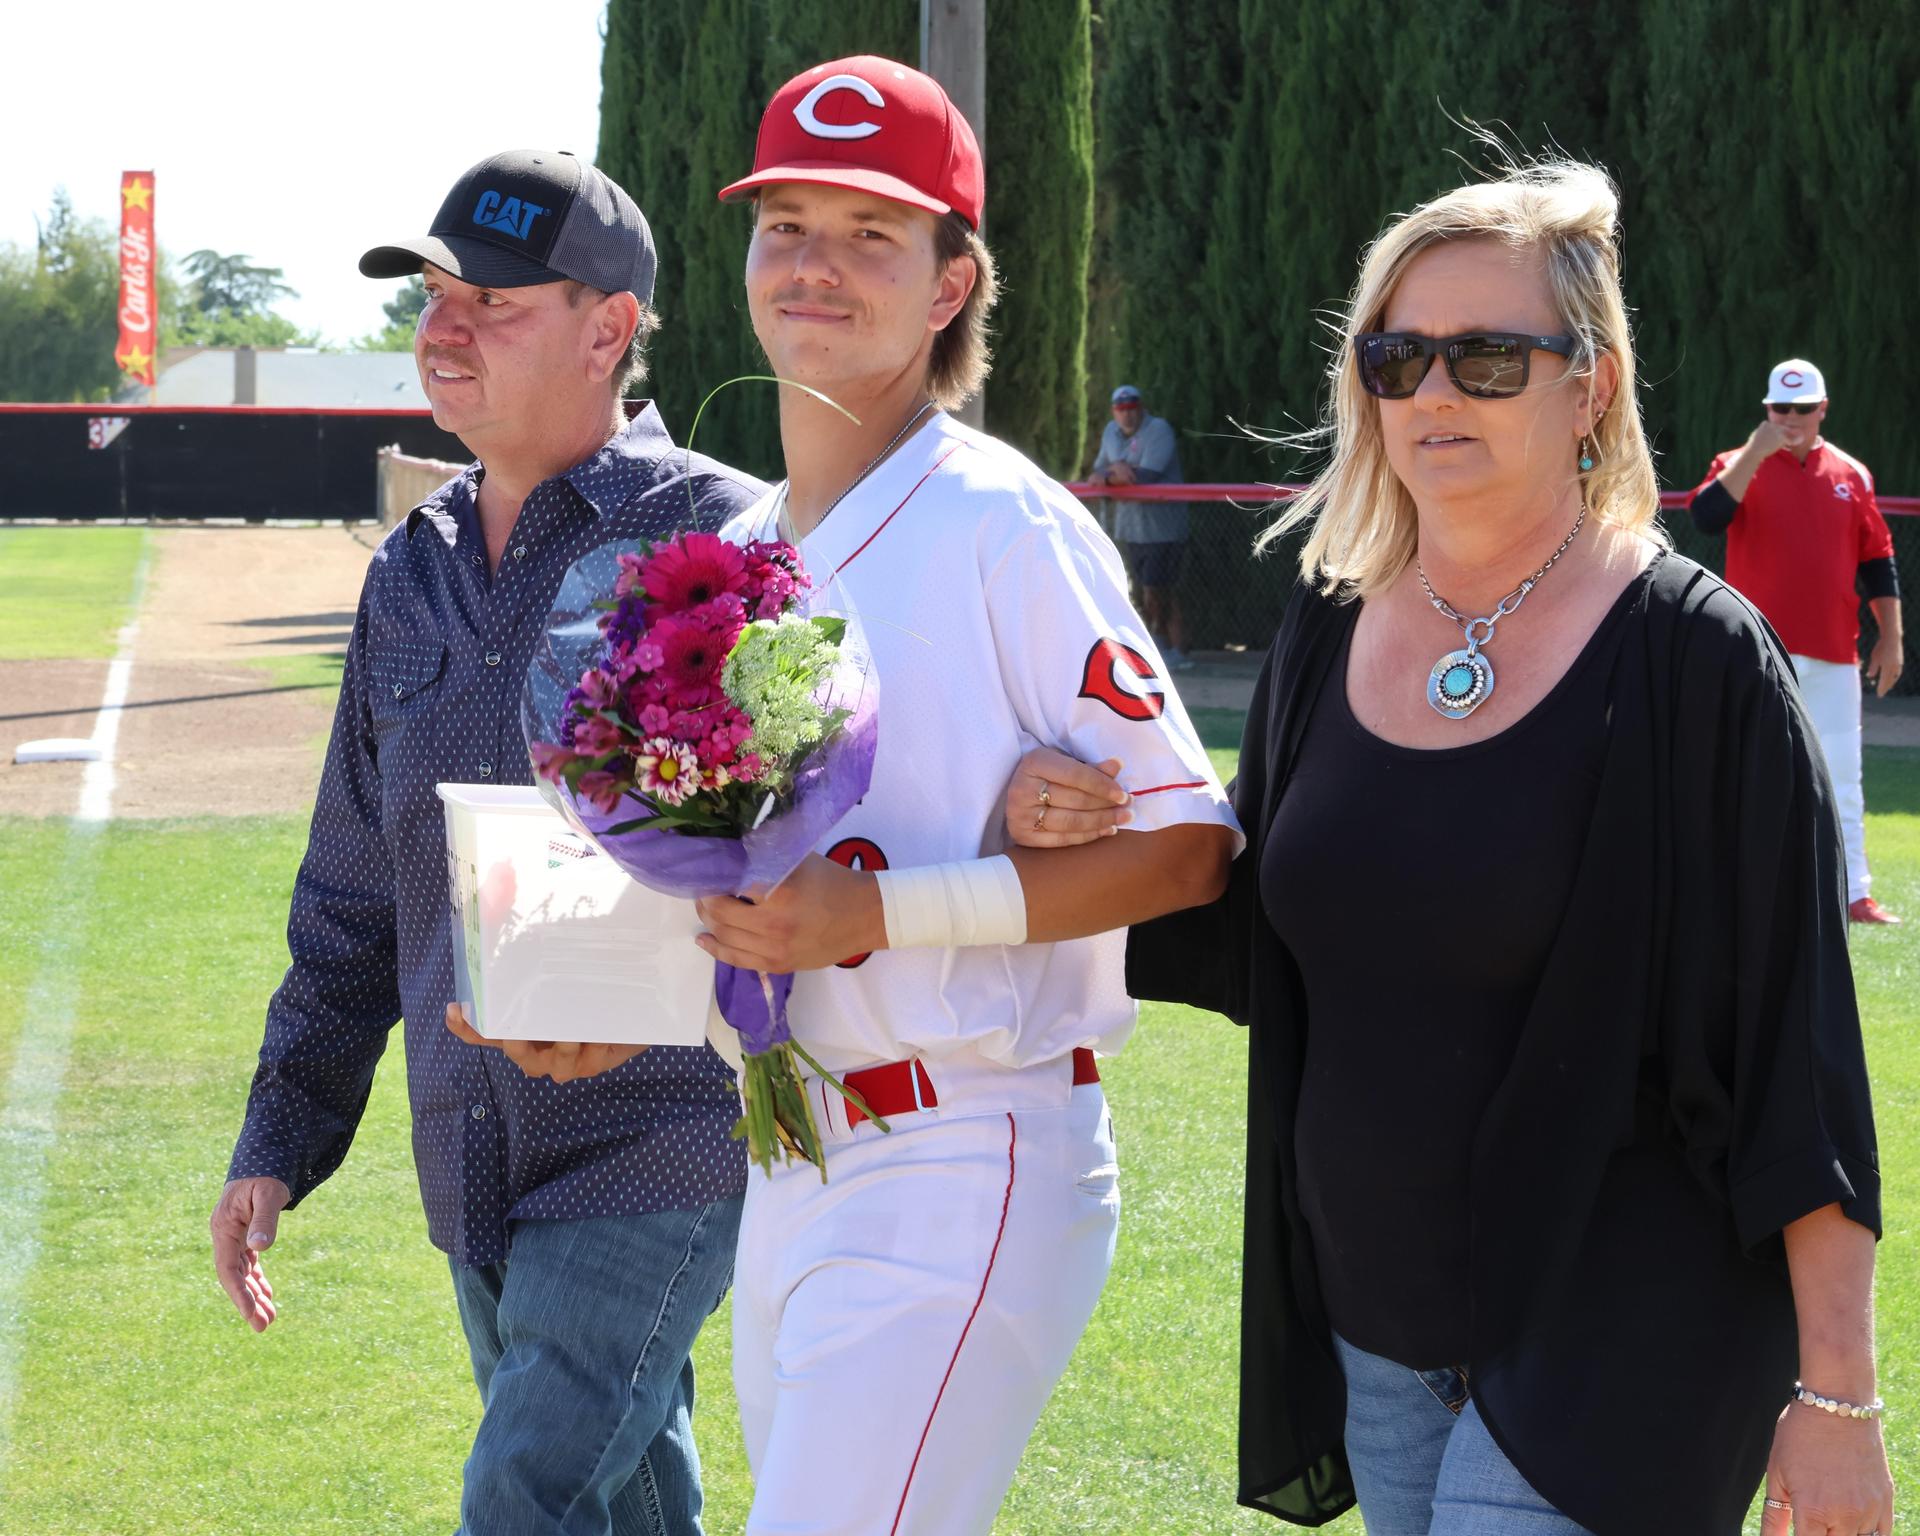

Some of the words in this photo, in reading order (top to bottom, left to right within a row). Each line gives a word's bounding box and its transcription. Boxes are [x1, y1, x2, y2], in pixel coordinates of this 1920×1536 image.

[792, 74, 886, 141] C
[472, 190, 544, 241] CAT
[120, 225, 150, 262] Jr.
[1780, 370, 1803, 389] C
[1077, 637, 1164, 721] C
